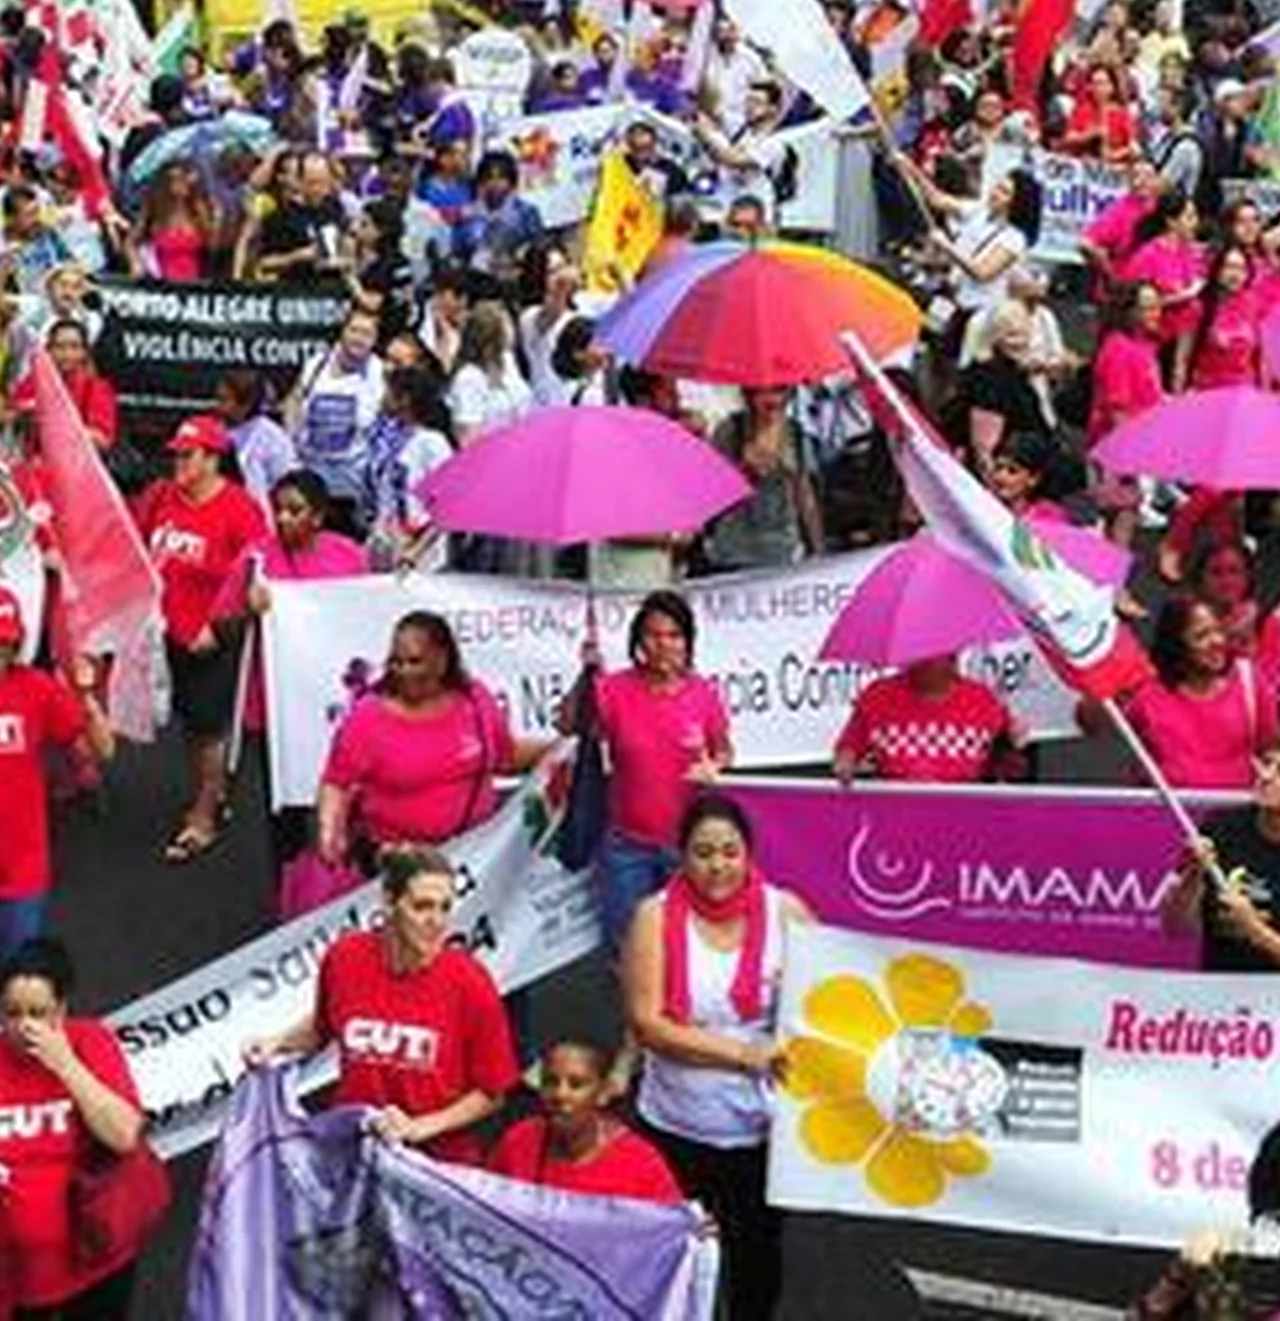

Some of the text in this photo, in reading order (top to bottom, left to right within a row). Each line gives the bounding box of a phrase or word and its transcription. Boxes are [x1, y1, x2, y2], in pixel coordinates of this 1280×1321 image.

[124, 333, 326, 365] VIOLÊNCIA CONT
[705, 583, 850, 622] MULHERE
[343, 1017, 439, 1068] CUT
[1106, 1000, 1274, 1068] Redução
[1150, 1141, 1180, 1189] 8
